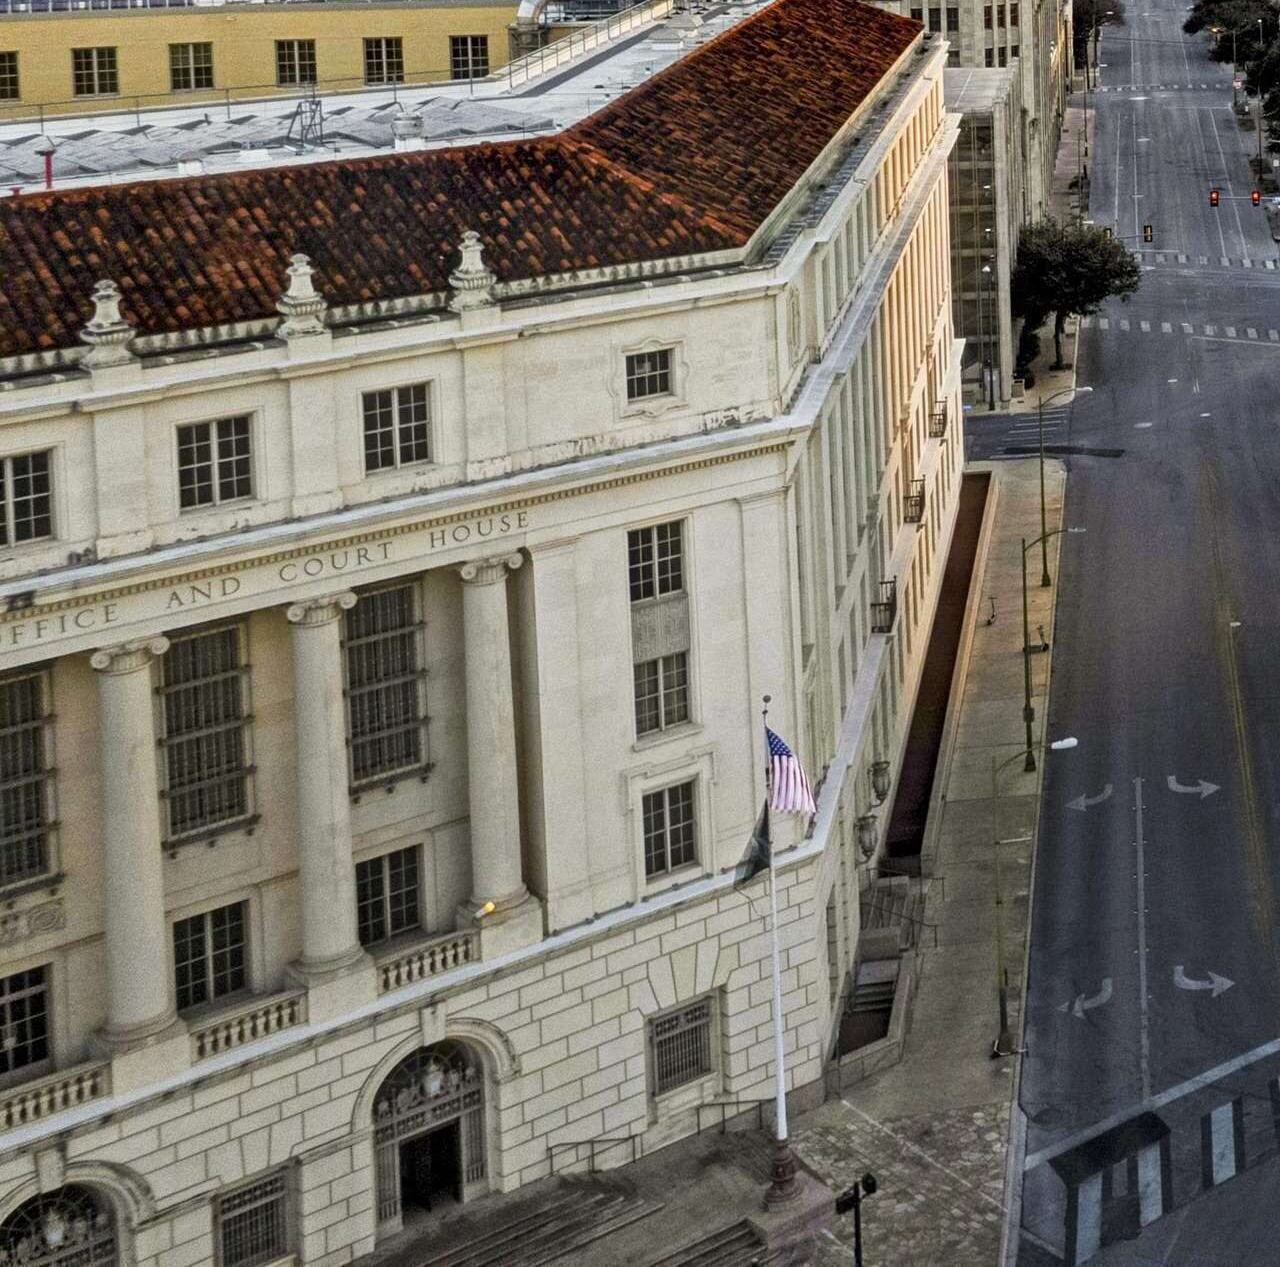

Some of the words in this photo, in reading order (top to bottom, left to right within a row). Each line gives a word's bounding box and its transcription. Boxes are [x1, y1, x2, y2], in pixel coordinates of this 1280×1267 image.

[0, 603, 119, 645] FFICE
[166, 576, 241, 609] AND
[279, 541, 393, 582] COURT
[429, 510, 529, 549] HOUSE
